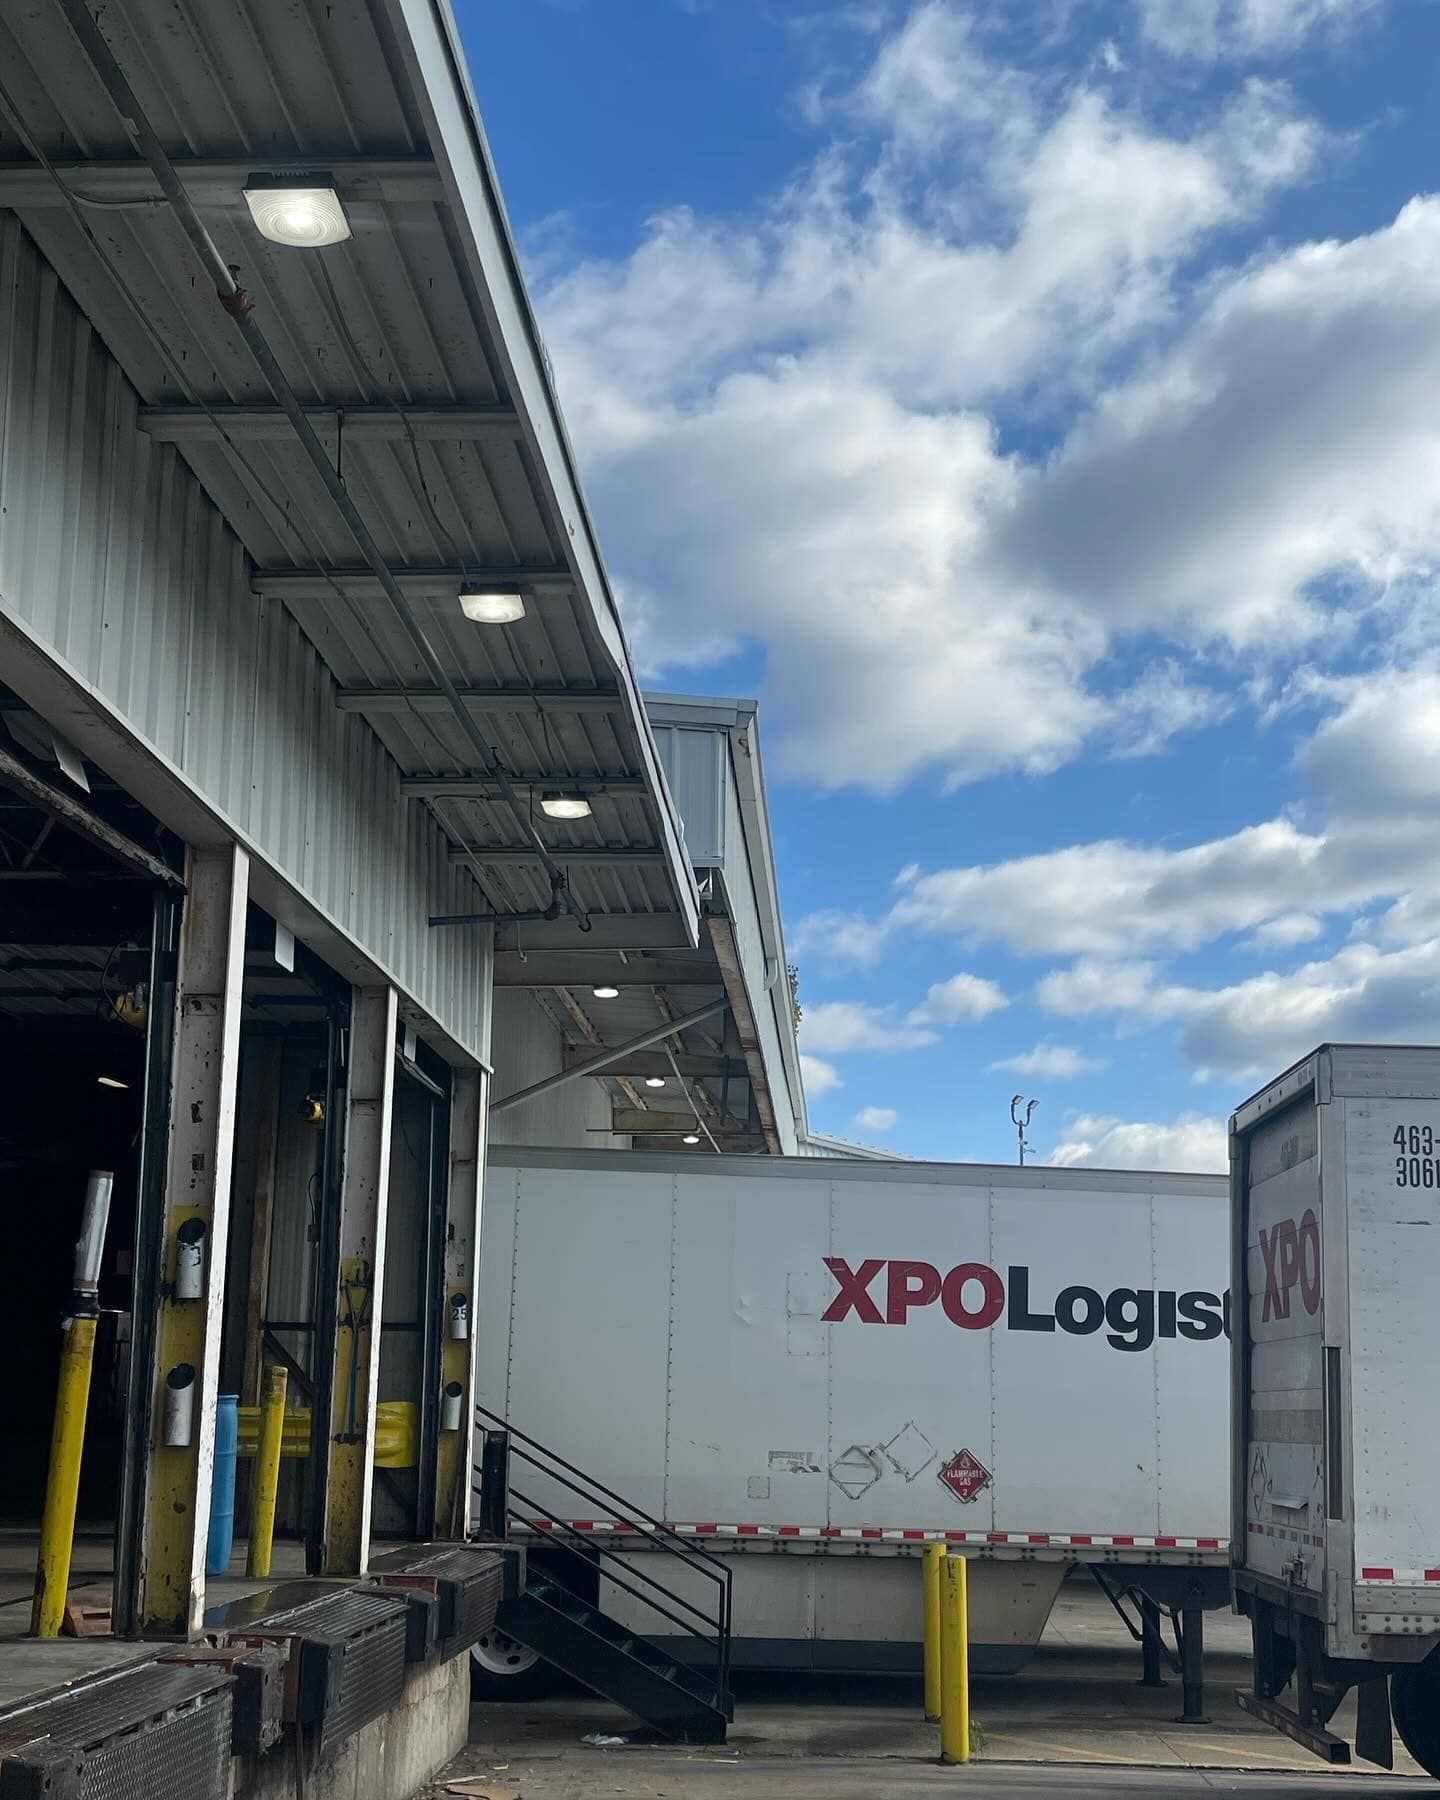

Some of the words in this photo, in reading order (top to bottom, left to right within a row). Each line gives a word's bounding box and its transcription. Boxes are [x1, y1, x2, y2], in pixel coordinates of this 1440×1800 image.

[1258, 1208, 1321, 1323] XPO
[452, 1308, 468, 1321] 25
[947, 1470, 983, 1478] FLAMMABLE
[960, 1478, 971, 1486] GAS
